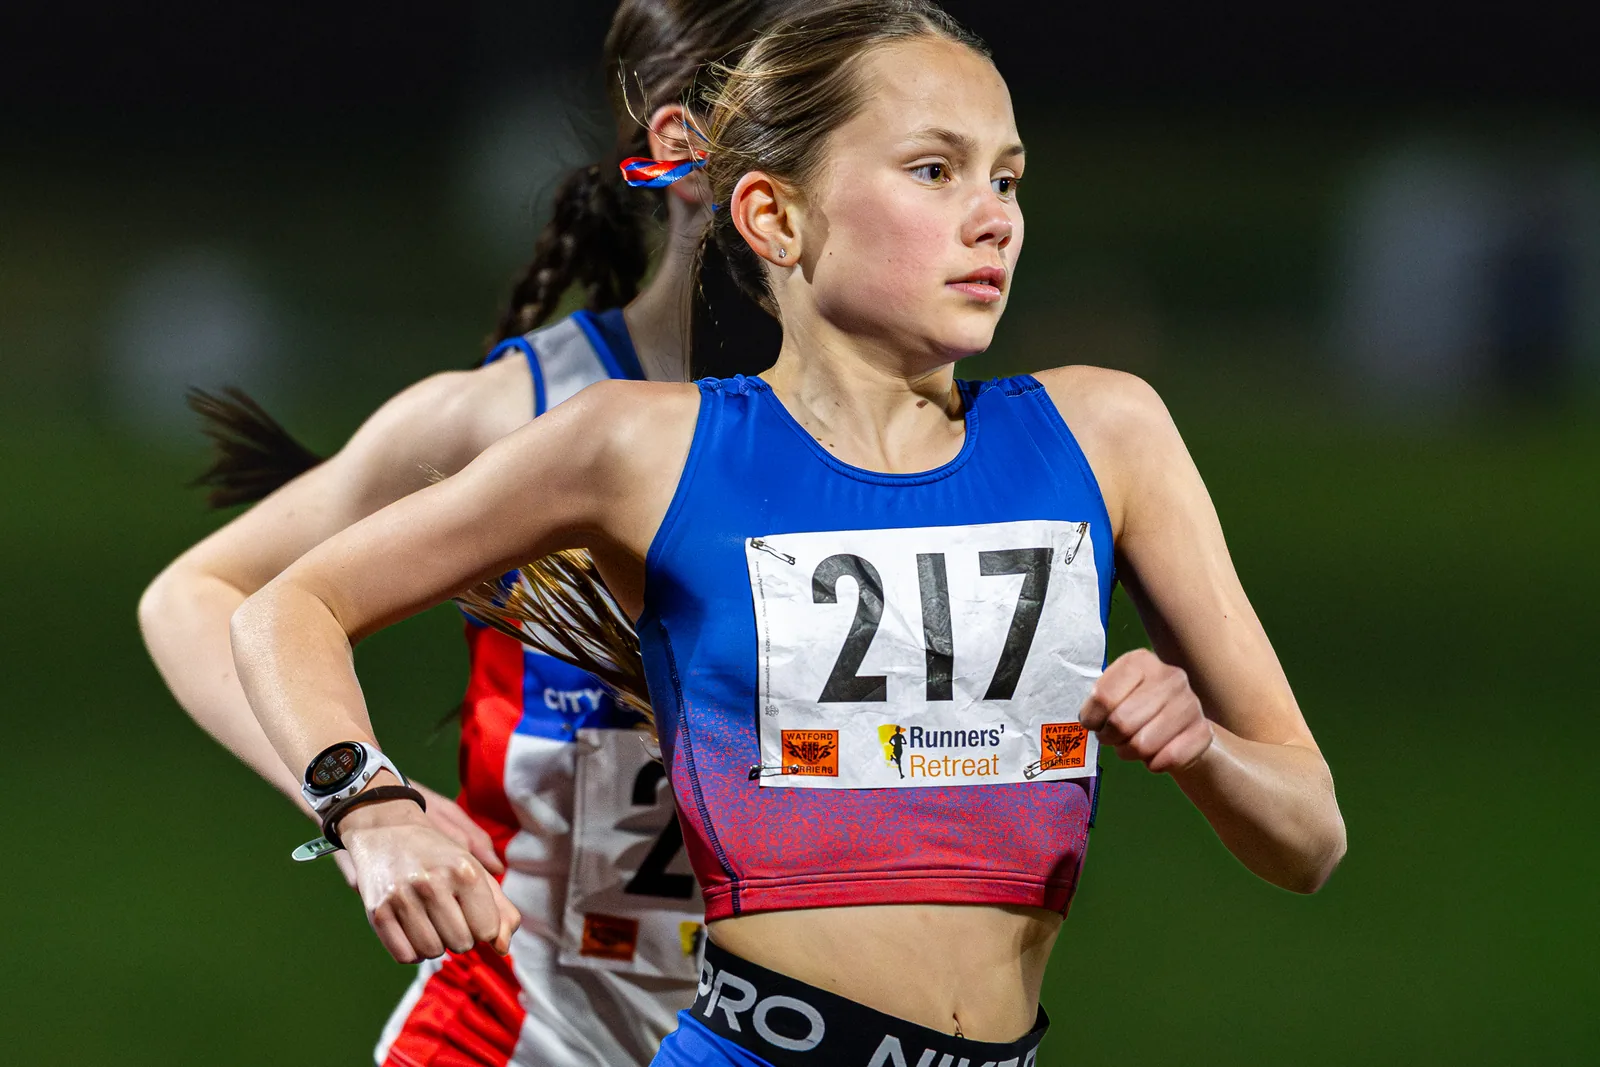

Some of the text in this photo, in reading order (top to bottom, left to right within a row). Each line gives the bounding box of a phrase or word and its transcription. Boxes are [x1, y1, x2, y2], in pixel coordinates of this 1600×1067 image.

[812, 548, 1054, 703] 217
[543, 687, 604, 713] CITY
[786, 733, 833, 741] WATFORD
[909, 724, 1005, 748] Runners'
[786, 765, 833, 774] RRIERS
[910, 753, 1000, 777] Retreat
[624, 757, 694, 899] 2
